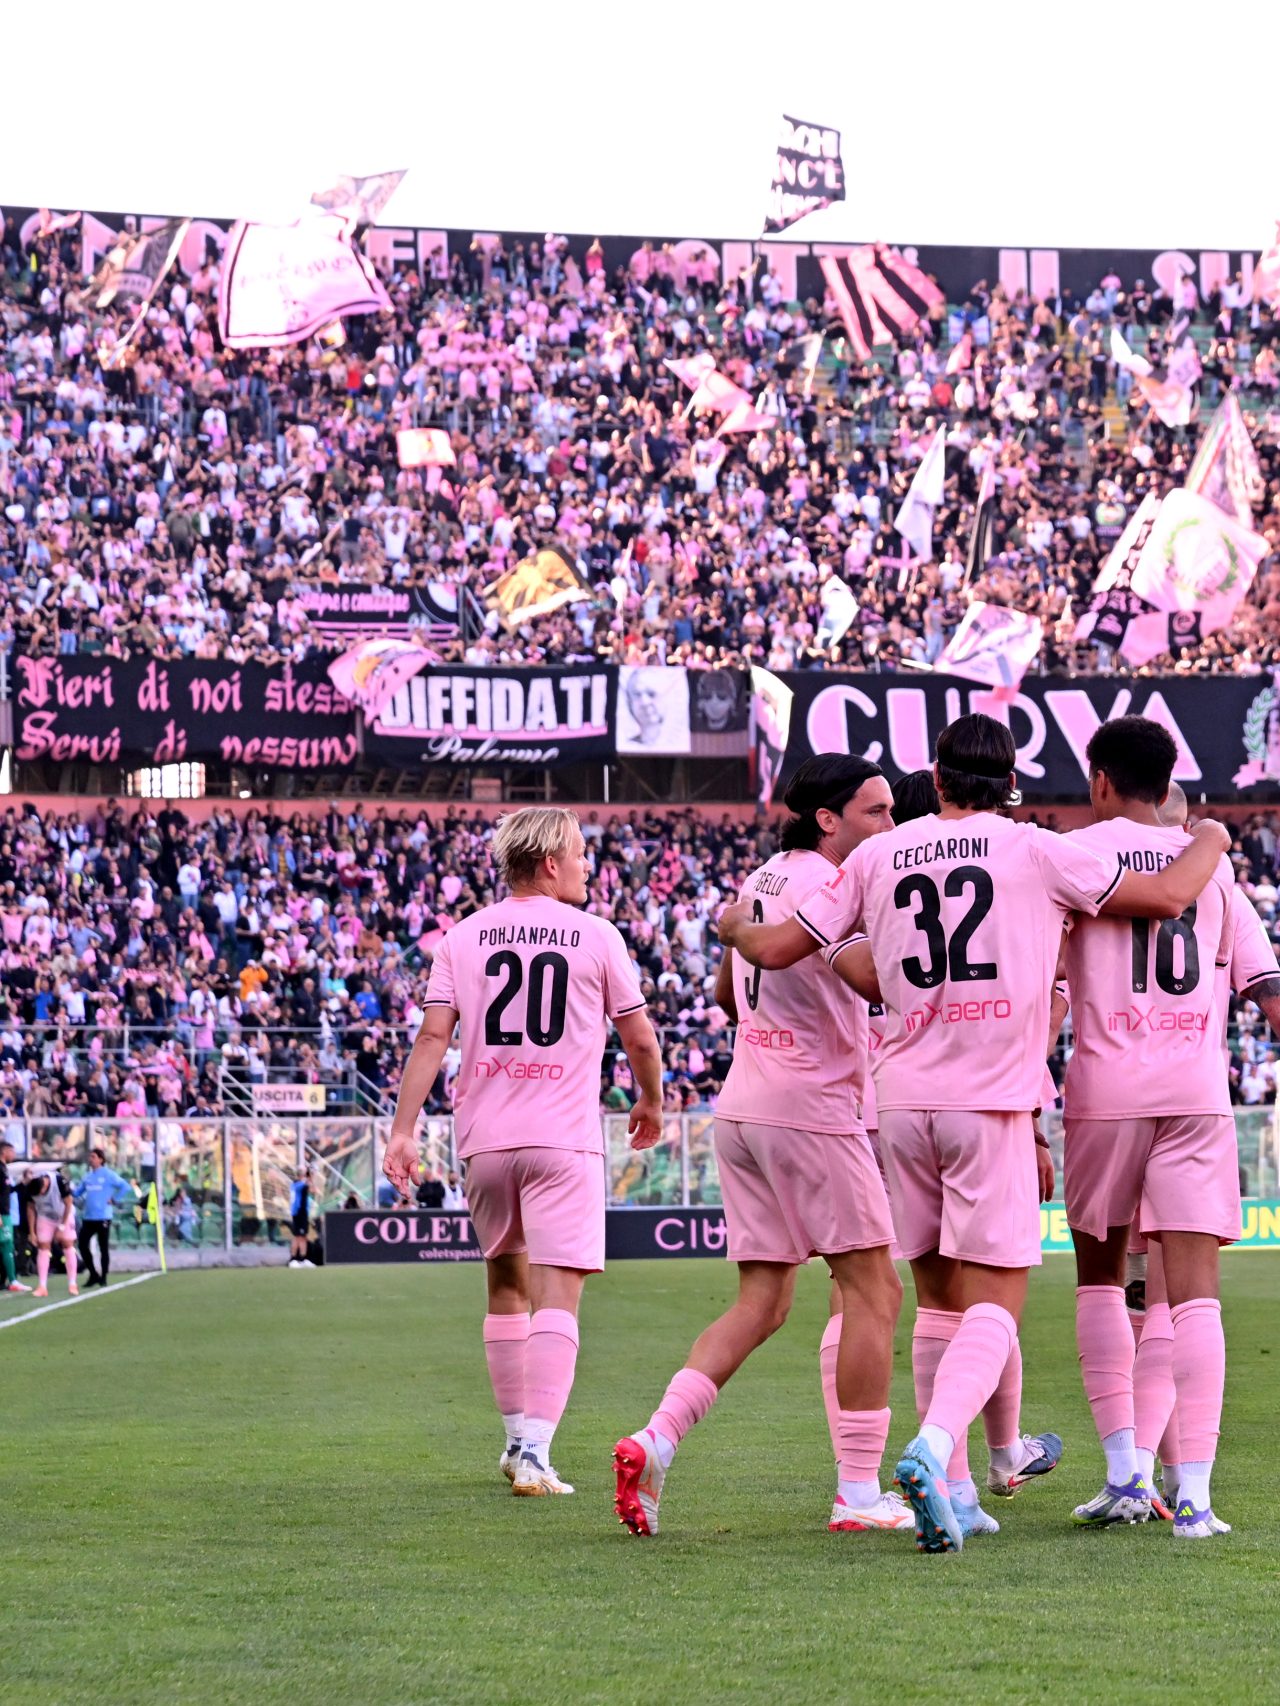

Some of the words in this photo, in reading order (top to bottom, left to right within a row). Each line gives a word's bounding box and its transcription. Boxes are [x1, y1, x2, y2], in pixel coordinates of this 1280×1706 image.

[138, 660, 170, 712] di
[188, 669, 243, 714] noi
[264, 664, 356, 716] stess
[153, 718, 188, 762] di
[422, 735, 559, 763] Palermo
[893, 837, 990, 870] CECCARONI
[479, 925, 581, 948] POHJANPALO
[893, 865, 998, 989] 32
[1131, 899, 1201, 996] 18
[484, 949, 569, 1047] 20
[254, 1090, 304, 1102] USCITA
[355, 1215, 473, 1243] COLET
